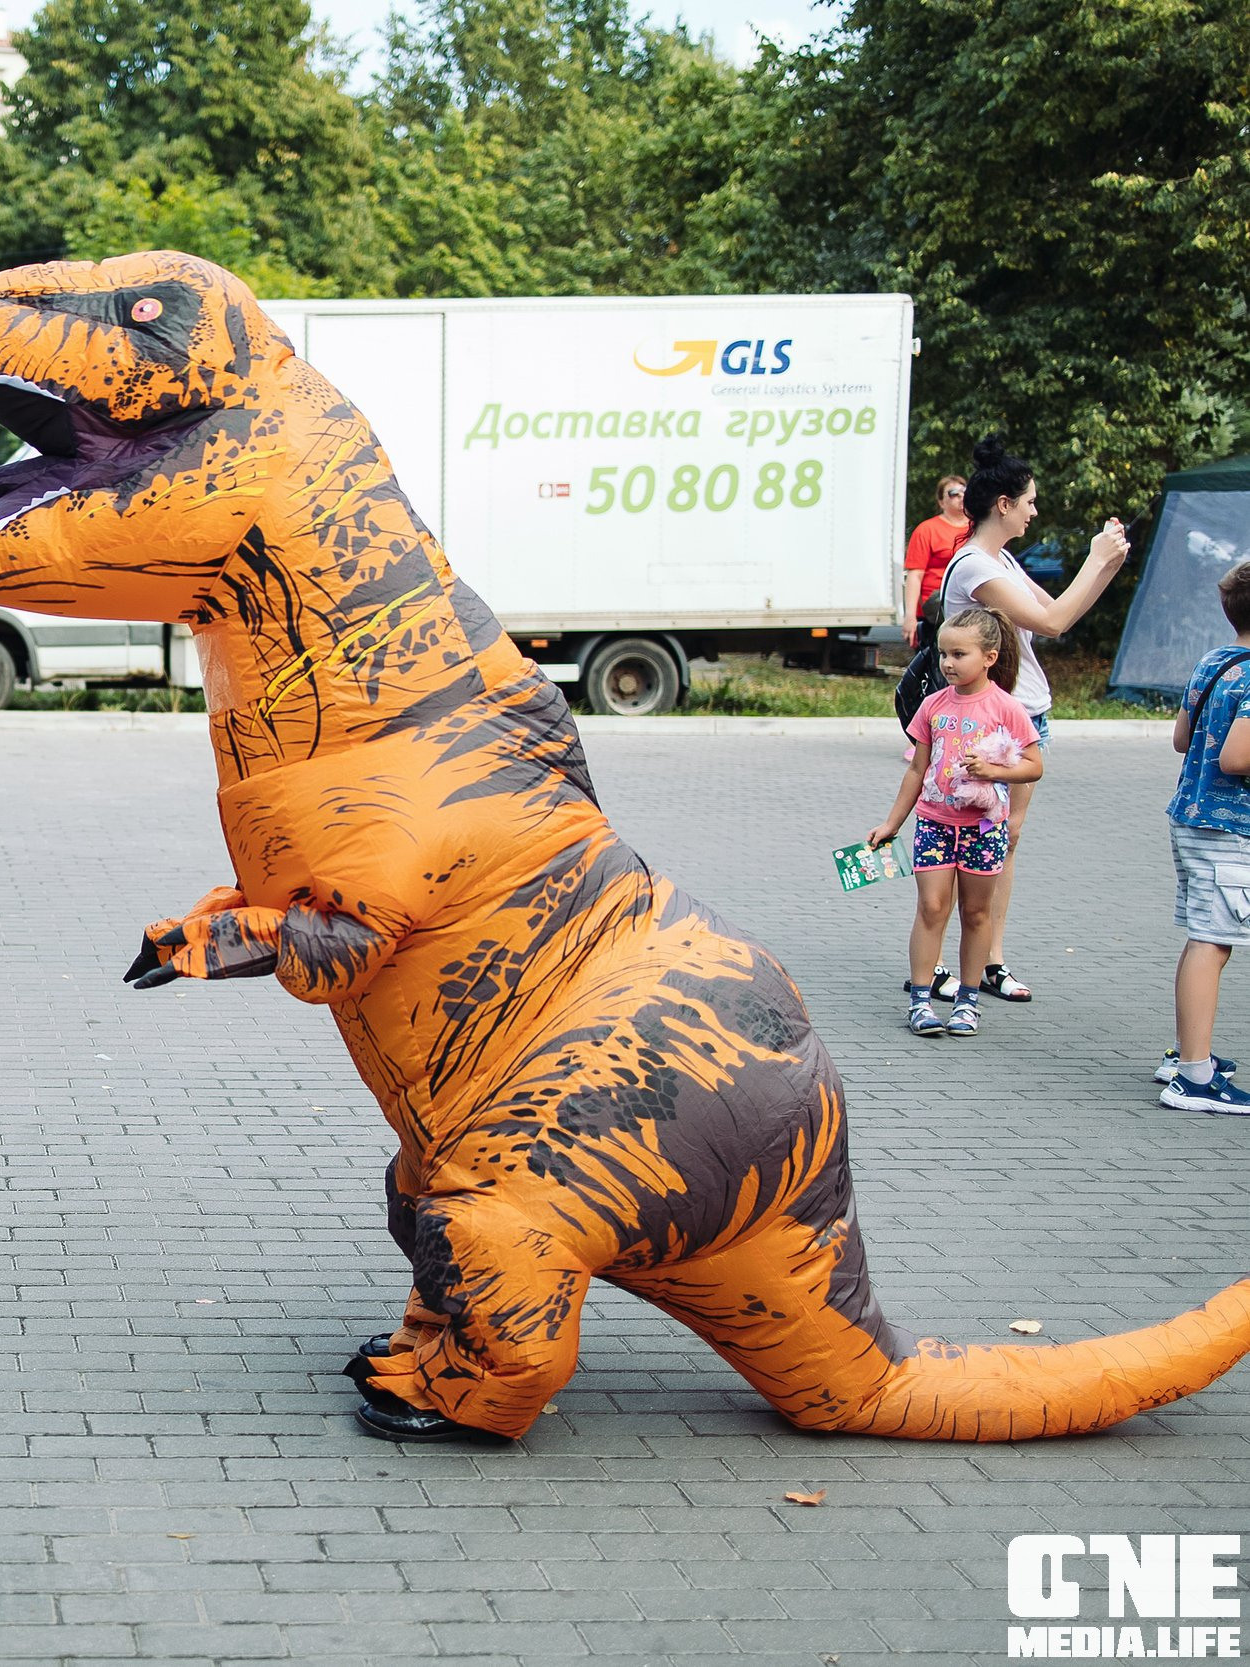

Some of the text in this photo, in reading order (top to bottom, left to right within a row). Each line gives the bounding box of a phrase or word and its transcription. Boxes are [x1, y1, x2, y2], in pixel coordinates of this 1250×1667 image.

[720, 338, 793, 376] GLS
[711, 381, 873, 396] General Logistics Systems
[463, 402, 877, 450] Доставка грузов
